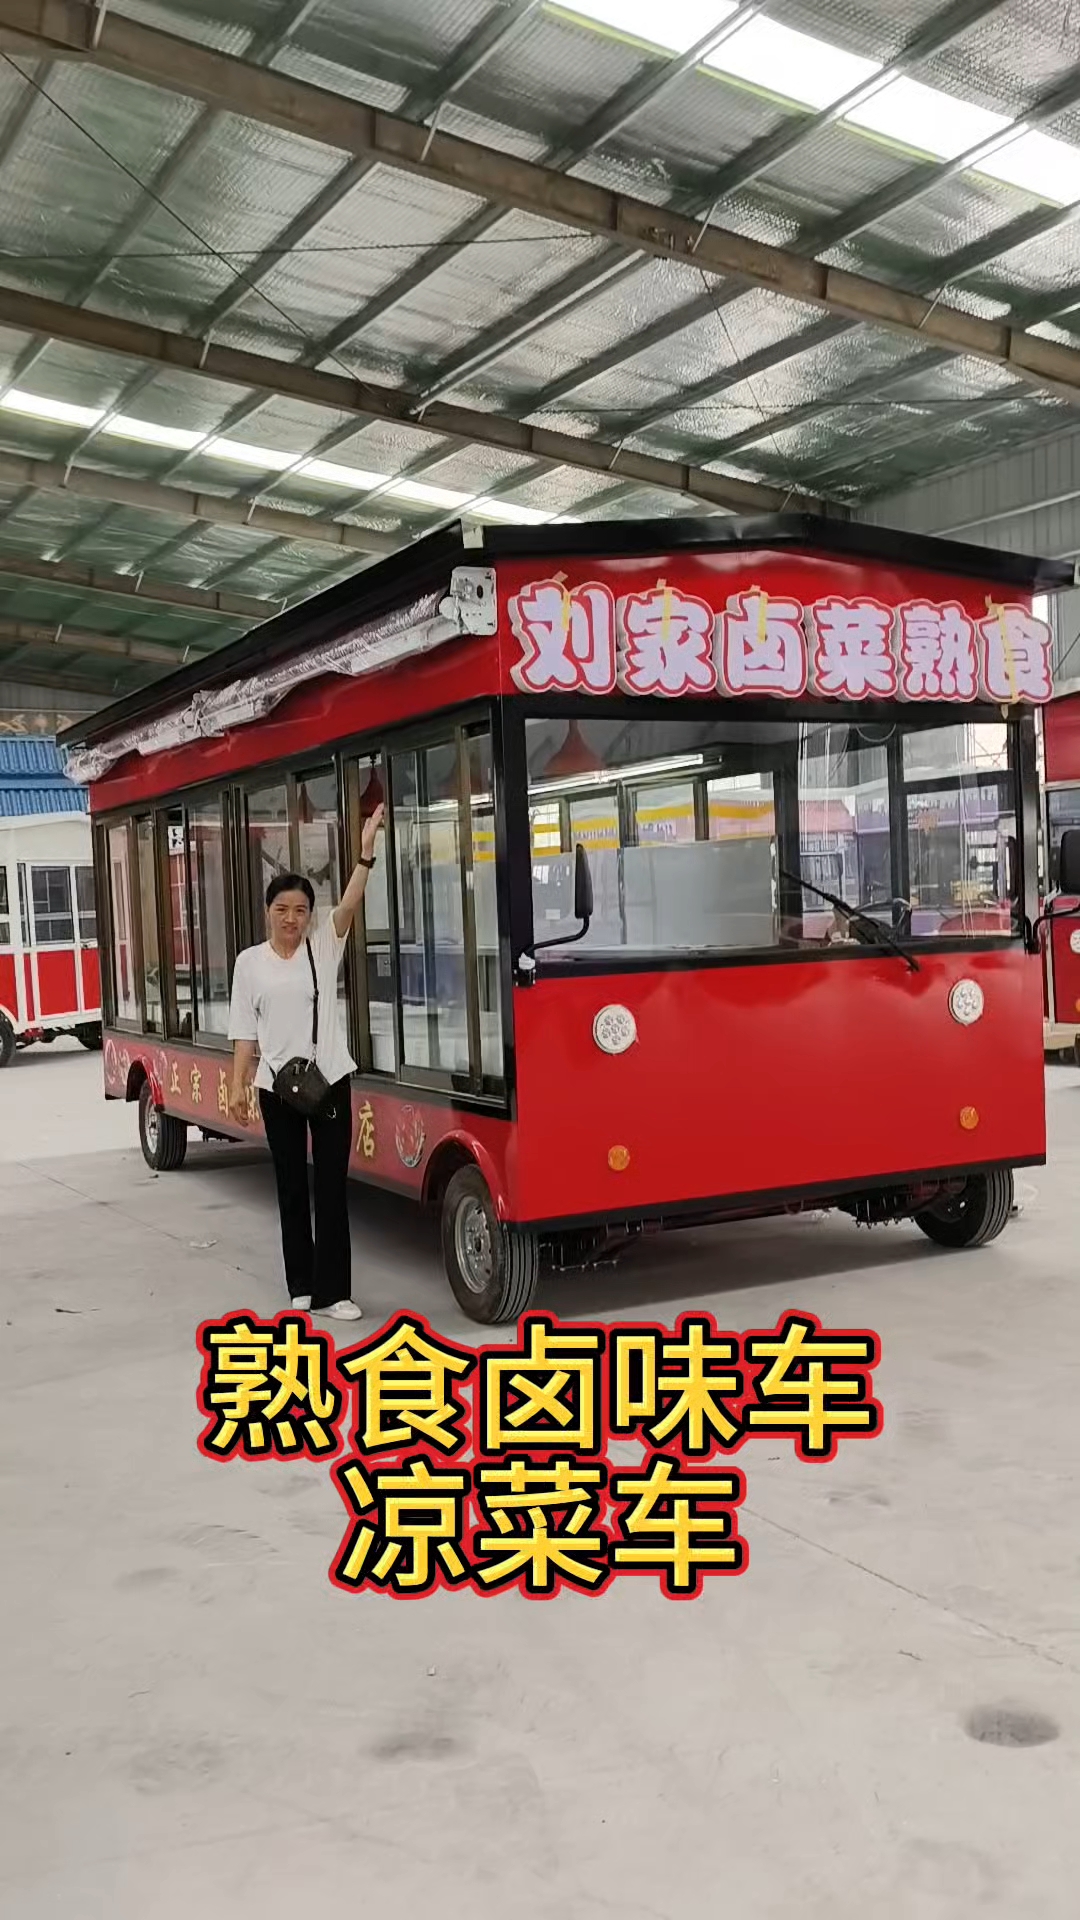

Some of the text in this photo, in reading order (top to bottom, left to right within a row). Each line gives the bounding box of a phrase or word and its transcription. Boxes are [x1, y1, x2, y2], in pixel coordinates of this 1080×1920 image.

[512, 581, 1054, 702] 刘家卤菜熟食
